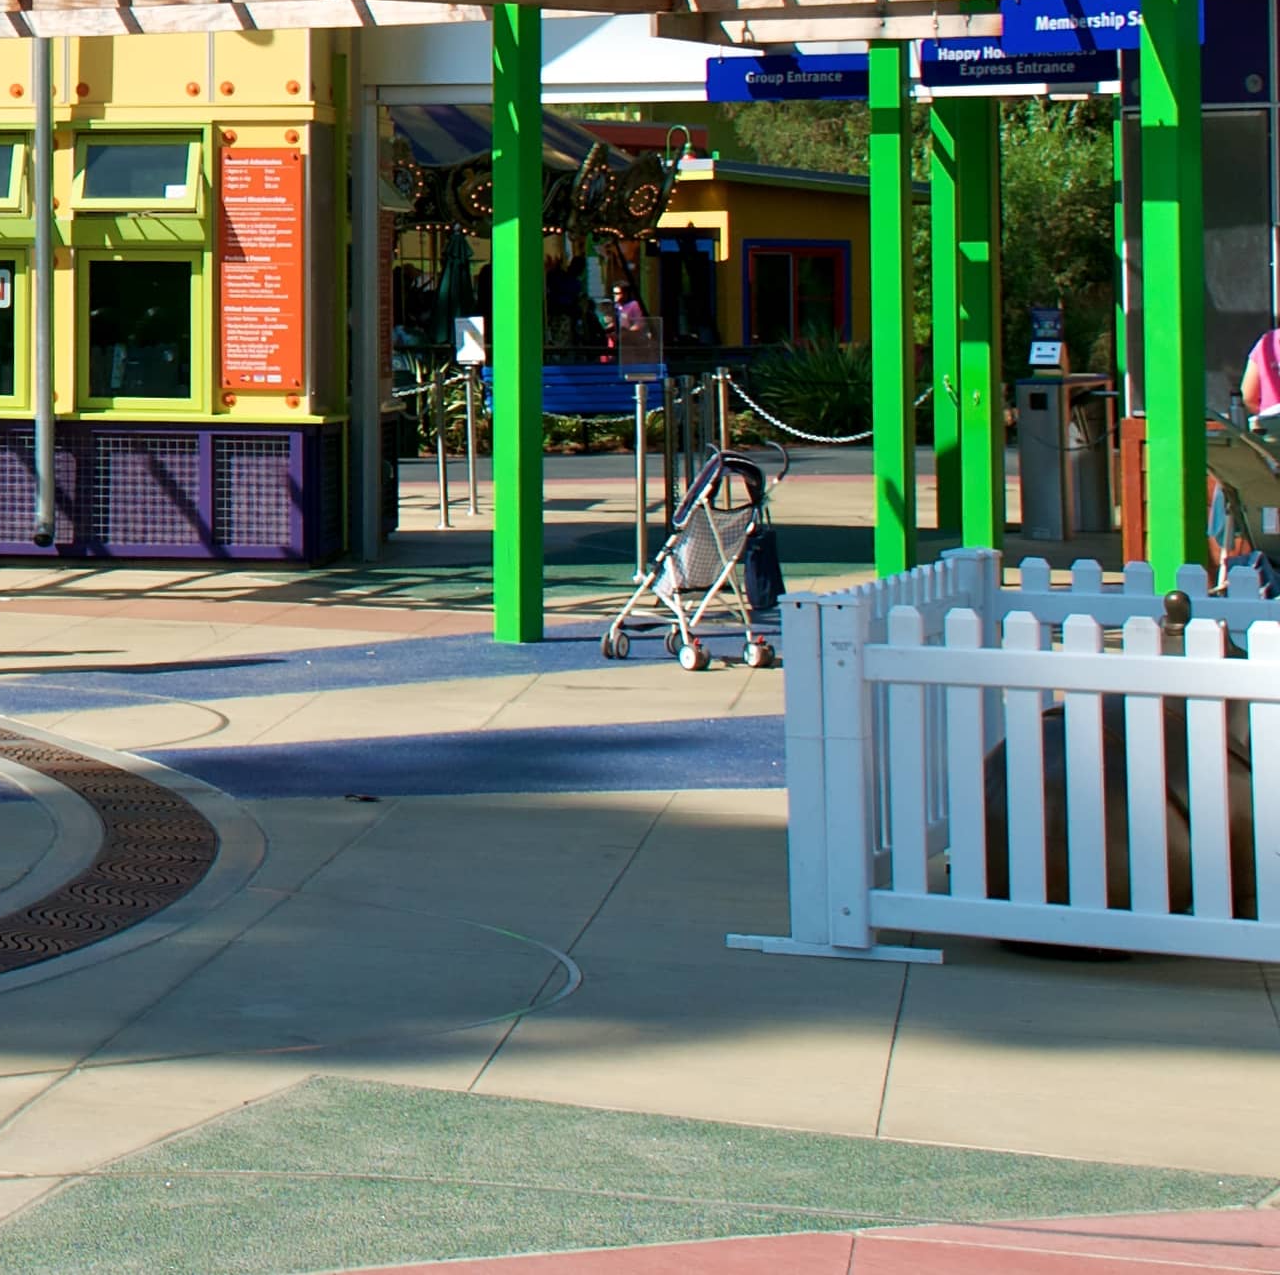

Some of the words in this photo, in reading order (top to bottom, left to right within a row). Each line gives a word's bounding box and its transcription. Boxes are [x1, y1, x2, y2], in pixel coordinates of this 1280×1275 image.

[1035, 12, 1125, 31] Membership
[938, 47, 981, 61] Happy
[960, 62, 1013, 77] Express
[1016, 60, 1076, 75] Entrance
[745, 70, 785, 86] Group
[787, 70, 843, 83] Entrance
